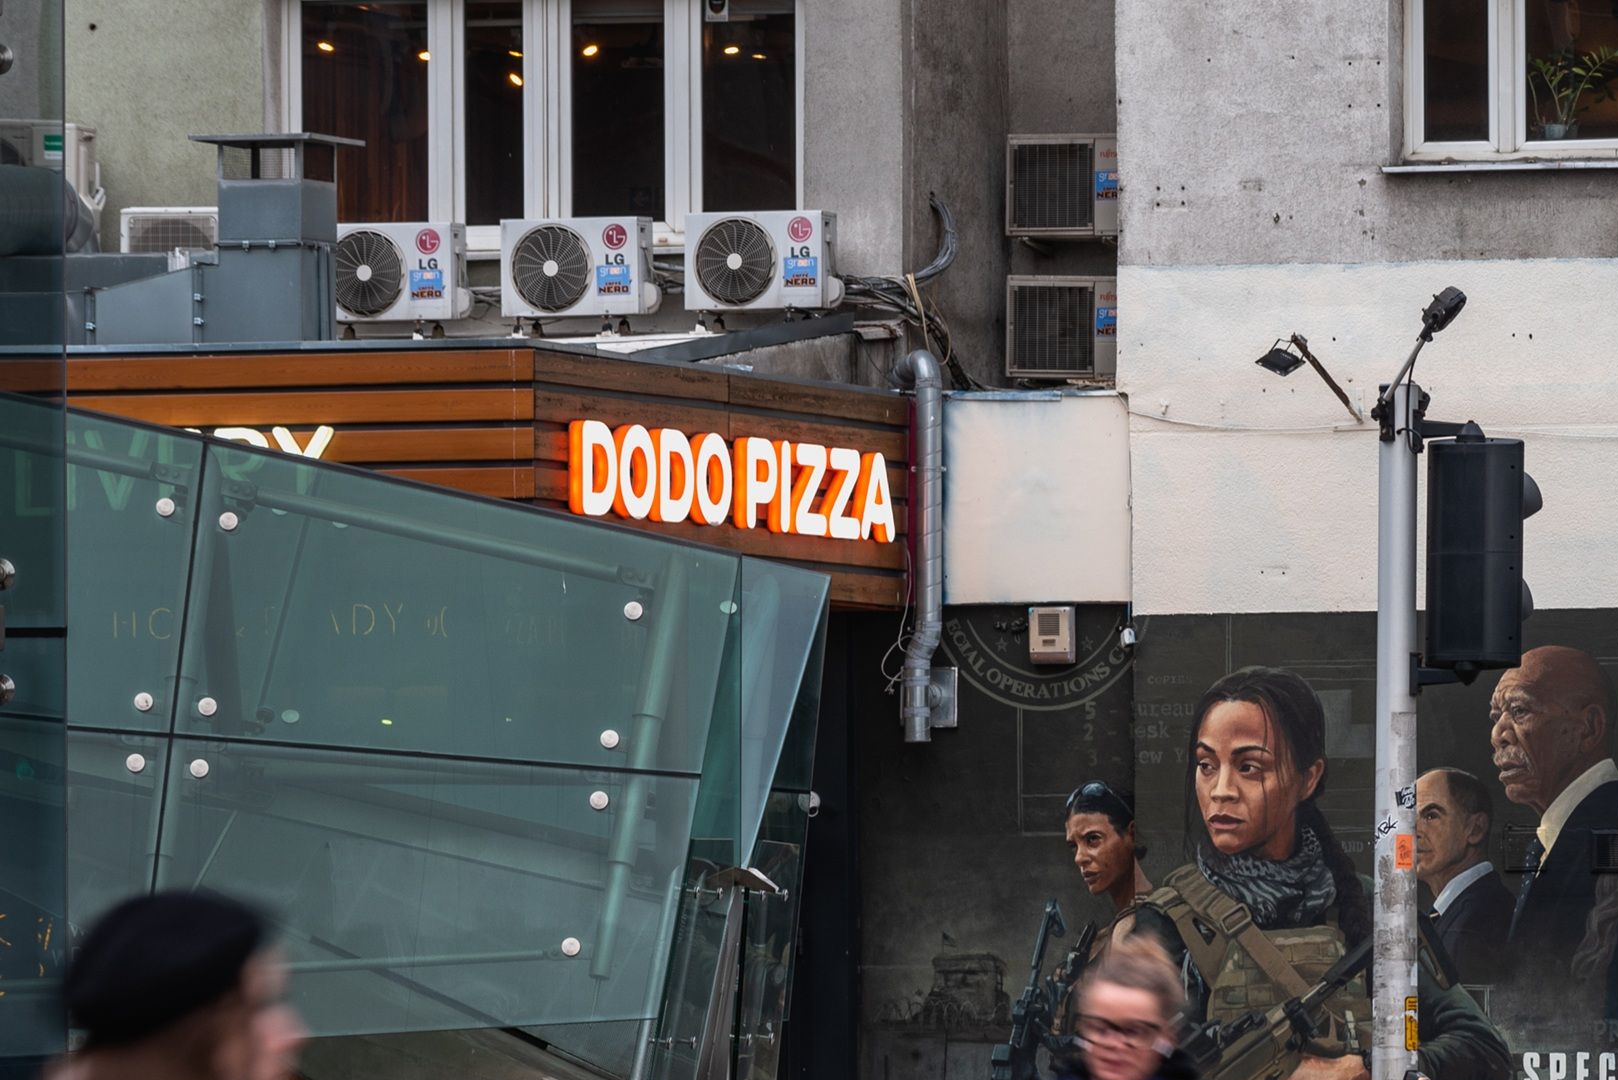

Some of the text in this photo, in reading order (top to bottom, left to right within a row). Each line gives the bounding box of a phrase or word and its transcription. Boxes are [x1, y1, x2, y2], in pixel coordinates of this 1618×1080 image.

[790, 246, 810, 258] LG
[418, 258, 438, 270] LG
[605, 253, 625, 265] LG
[569, 419, 896, 543] DODO PIZZA
[986, 661, 1111, 699] OPERATIONS
[1132, 702, 1195, 717] ureau
